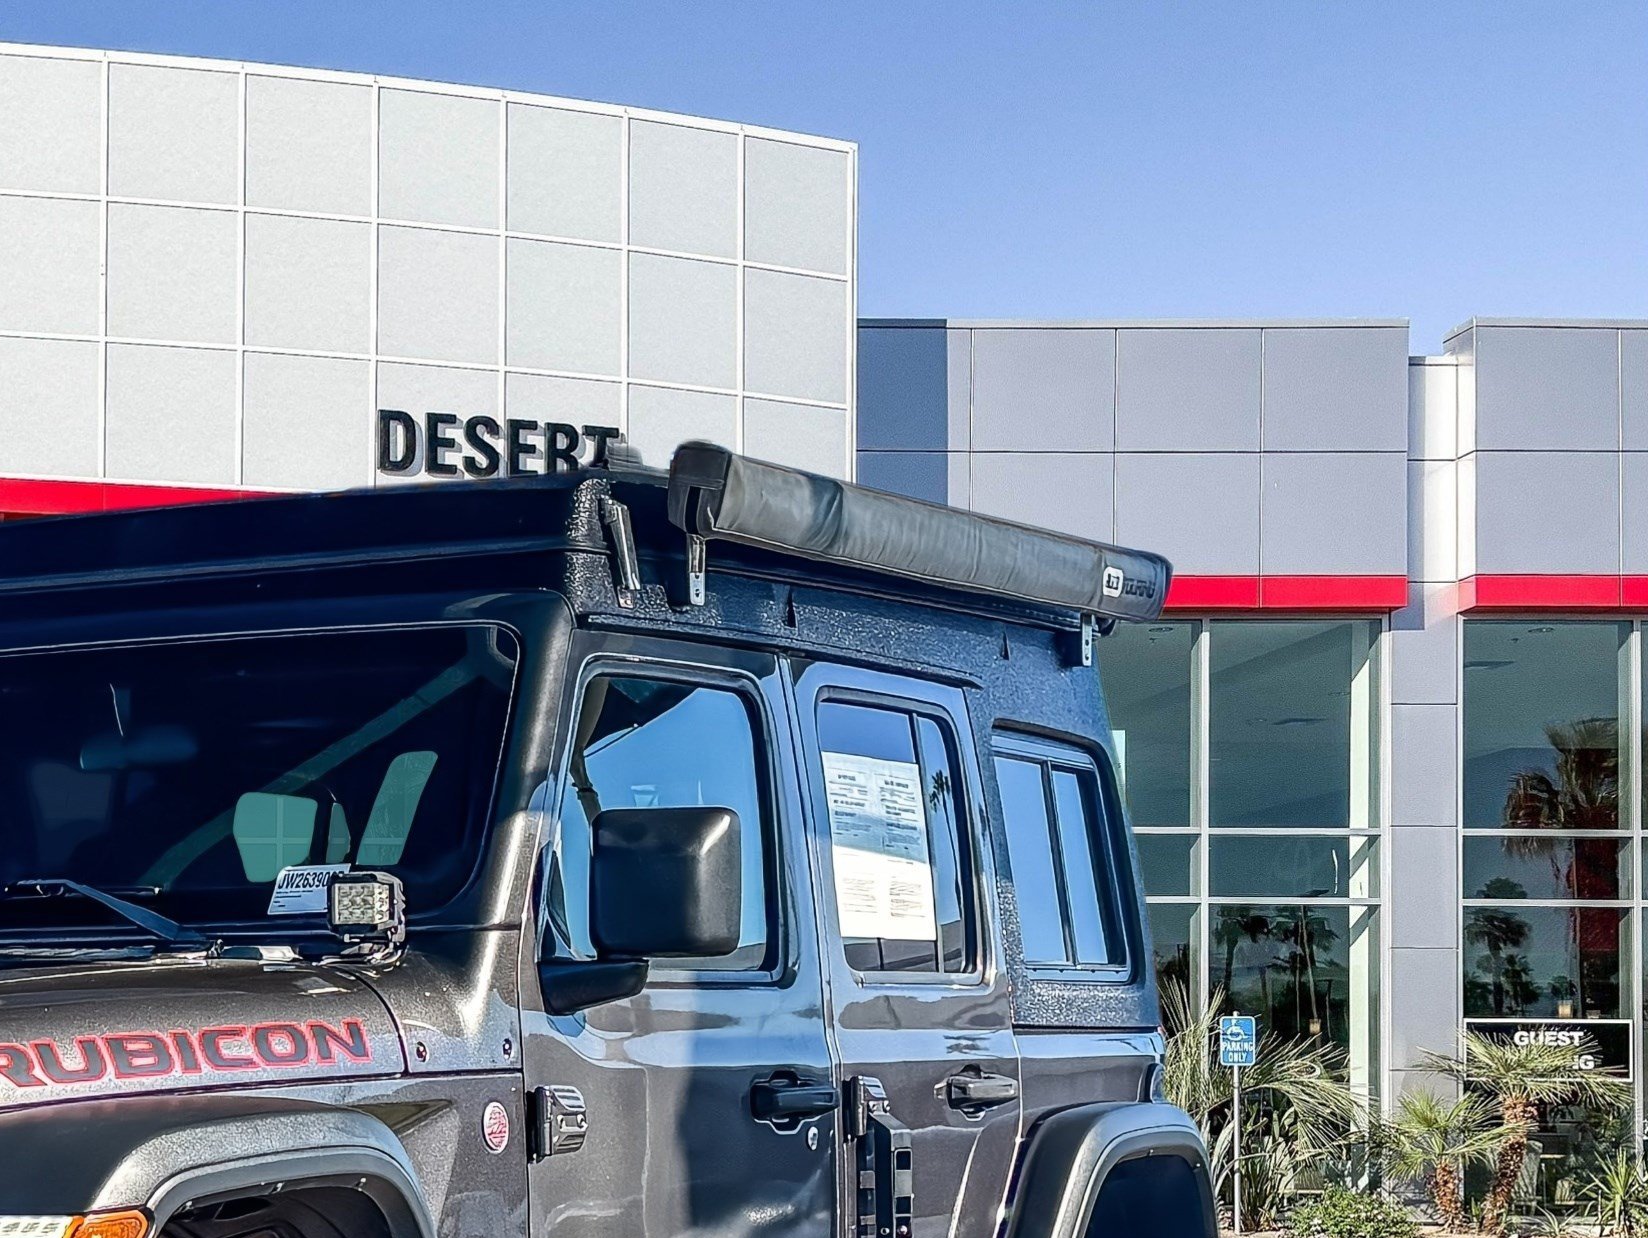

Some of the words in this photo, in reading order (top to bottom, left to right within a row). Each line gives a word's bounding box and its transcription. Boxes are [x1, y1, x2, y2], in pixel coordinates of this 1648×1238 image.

[377, 409, 620, 479] DESERT
[277, 870, 345, 890] JW26390
[1222, 1041, 1254, 1052] PARKING
[1513, 1030, 1584, 1047] GUEST
[1228, 1051, 1248, 1063] ONLY
